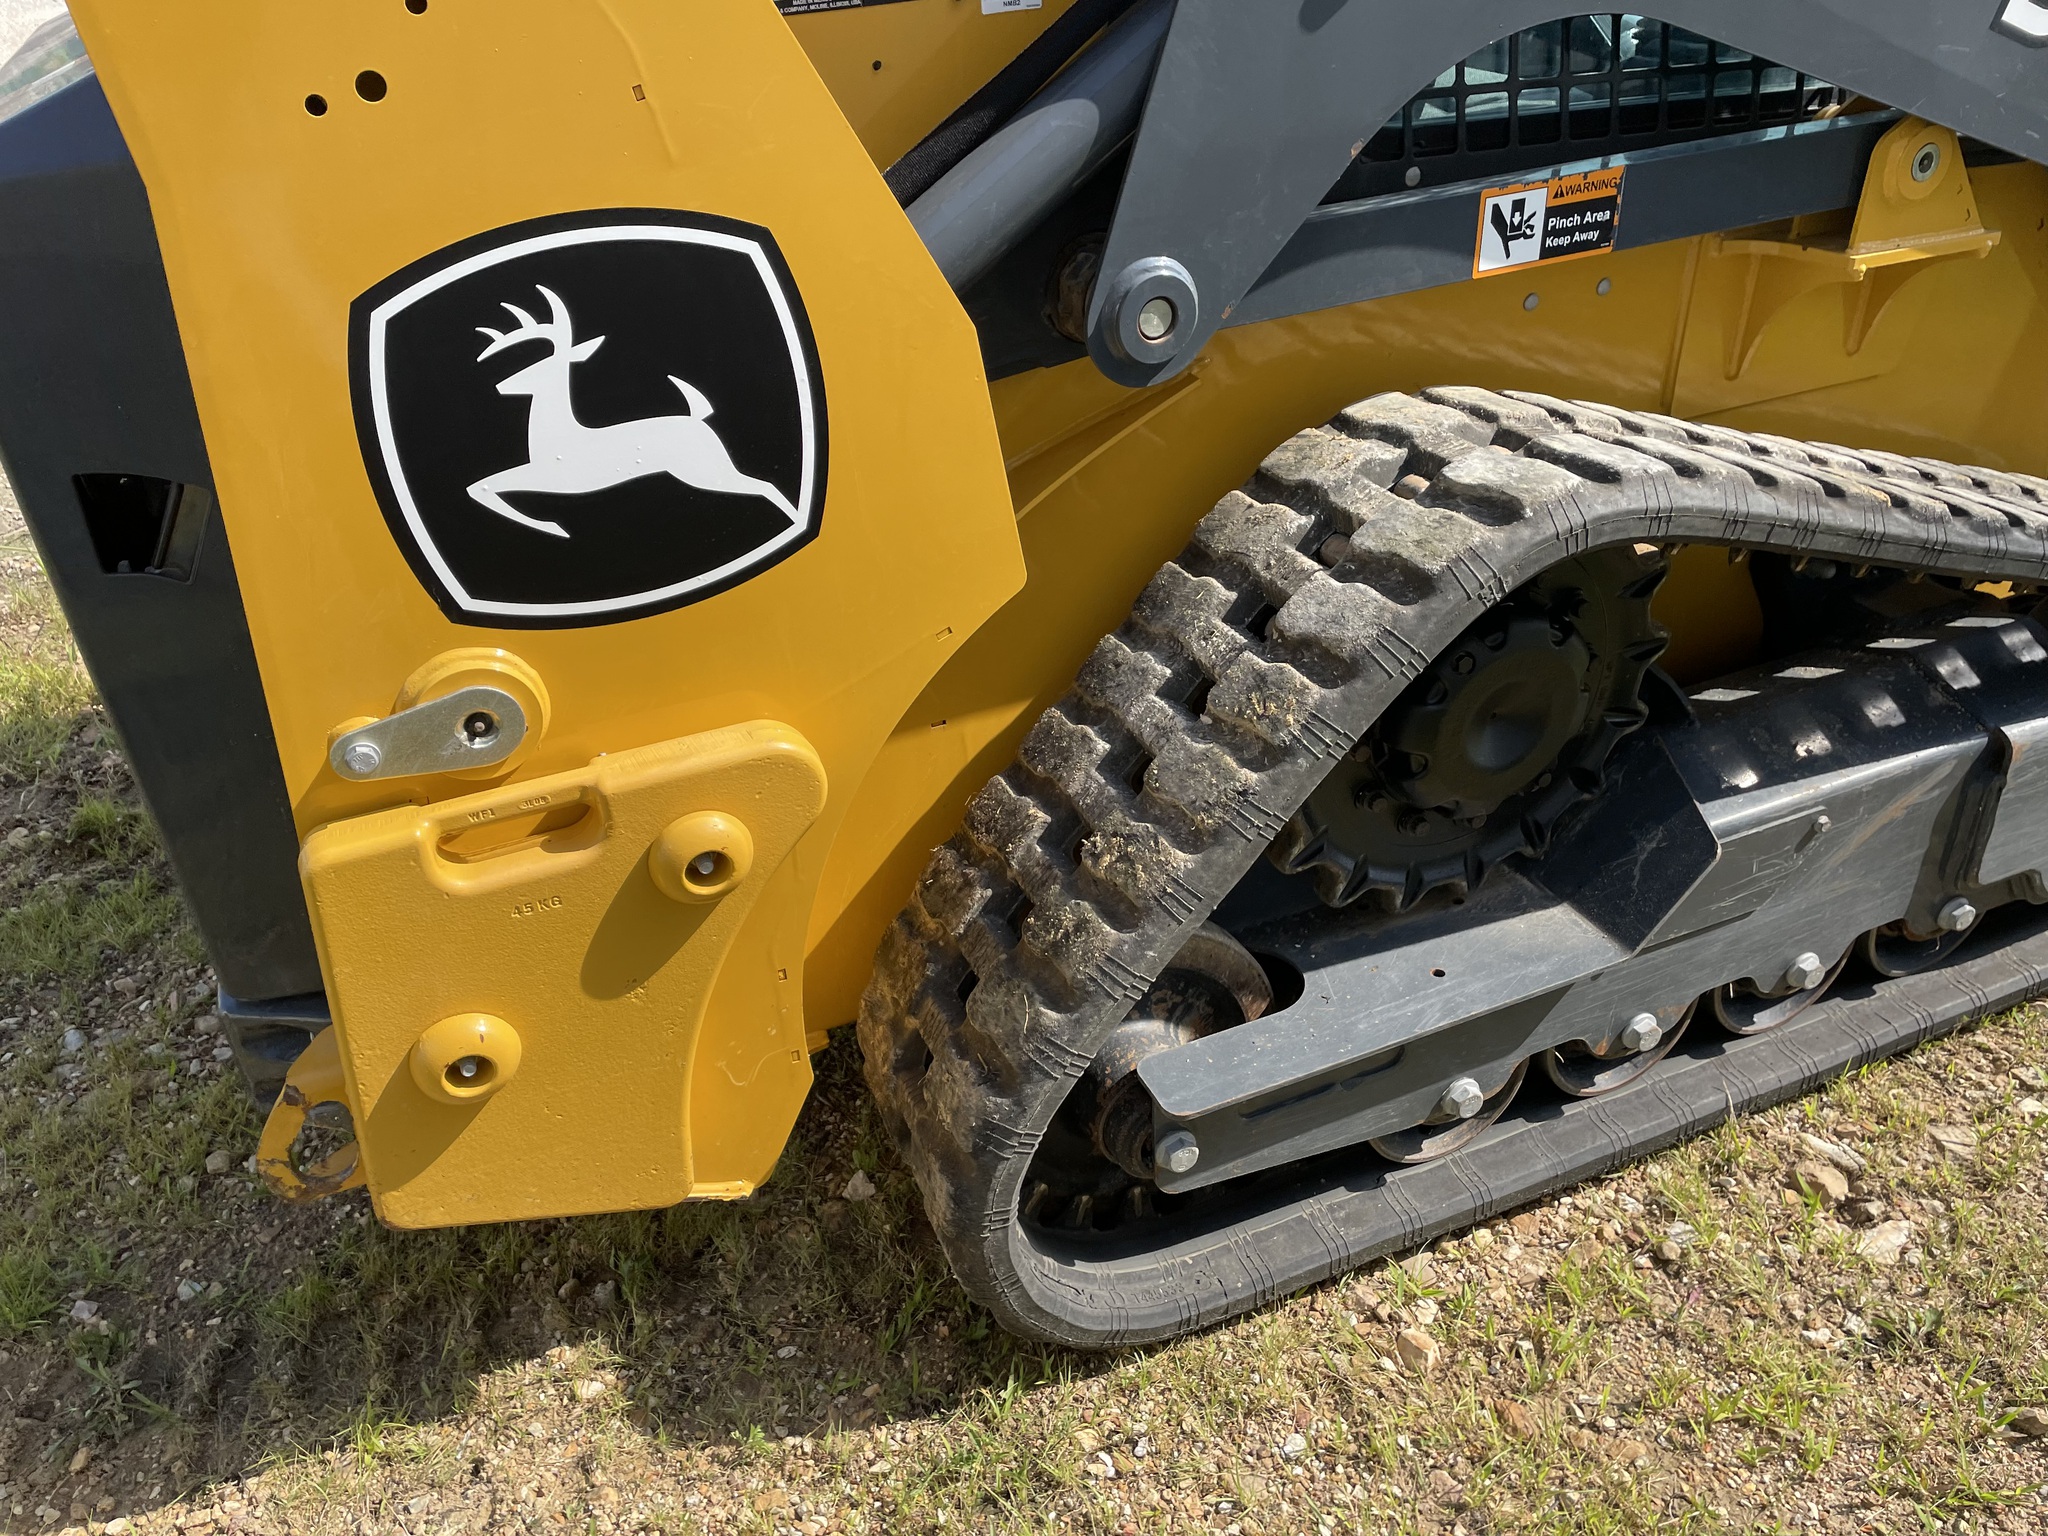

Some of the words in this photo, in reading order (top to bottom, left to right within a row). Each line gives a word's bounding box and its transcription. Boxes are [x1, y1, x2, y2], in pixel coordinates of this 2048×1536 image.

[1565, 177, 1618, 197] WARNING
[1547, 213, 1581, 231] Pinch
[1583, 210, 1611, 225] Area
[1545, 234, 1571, 248] Keep
[1572, 229, 1600, 243] Away
[511, 903, 535, 918] 45
[536, 895, 563, 912] KG
